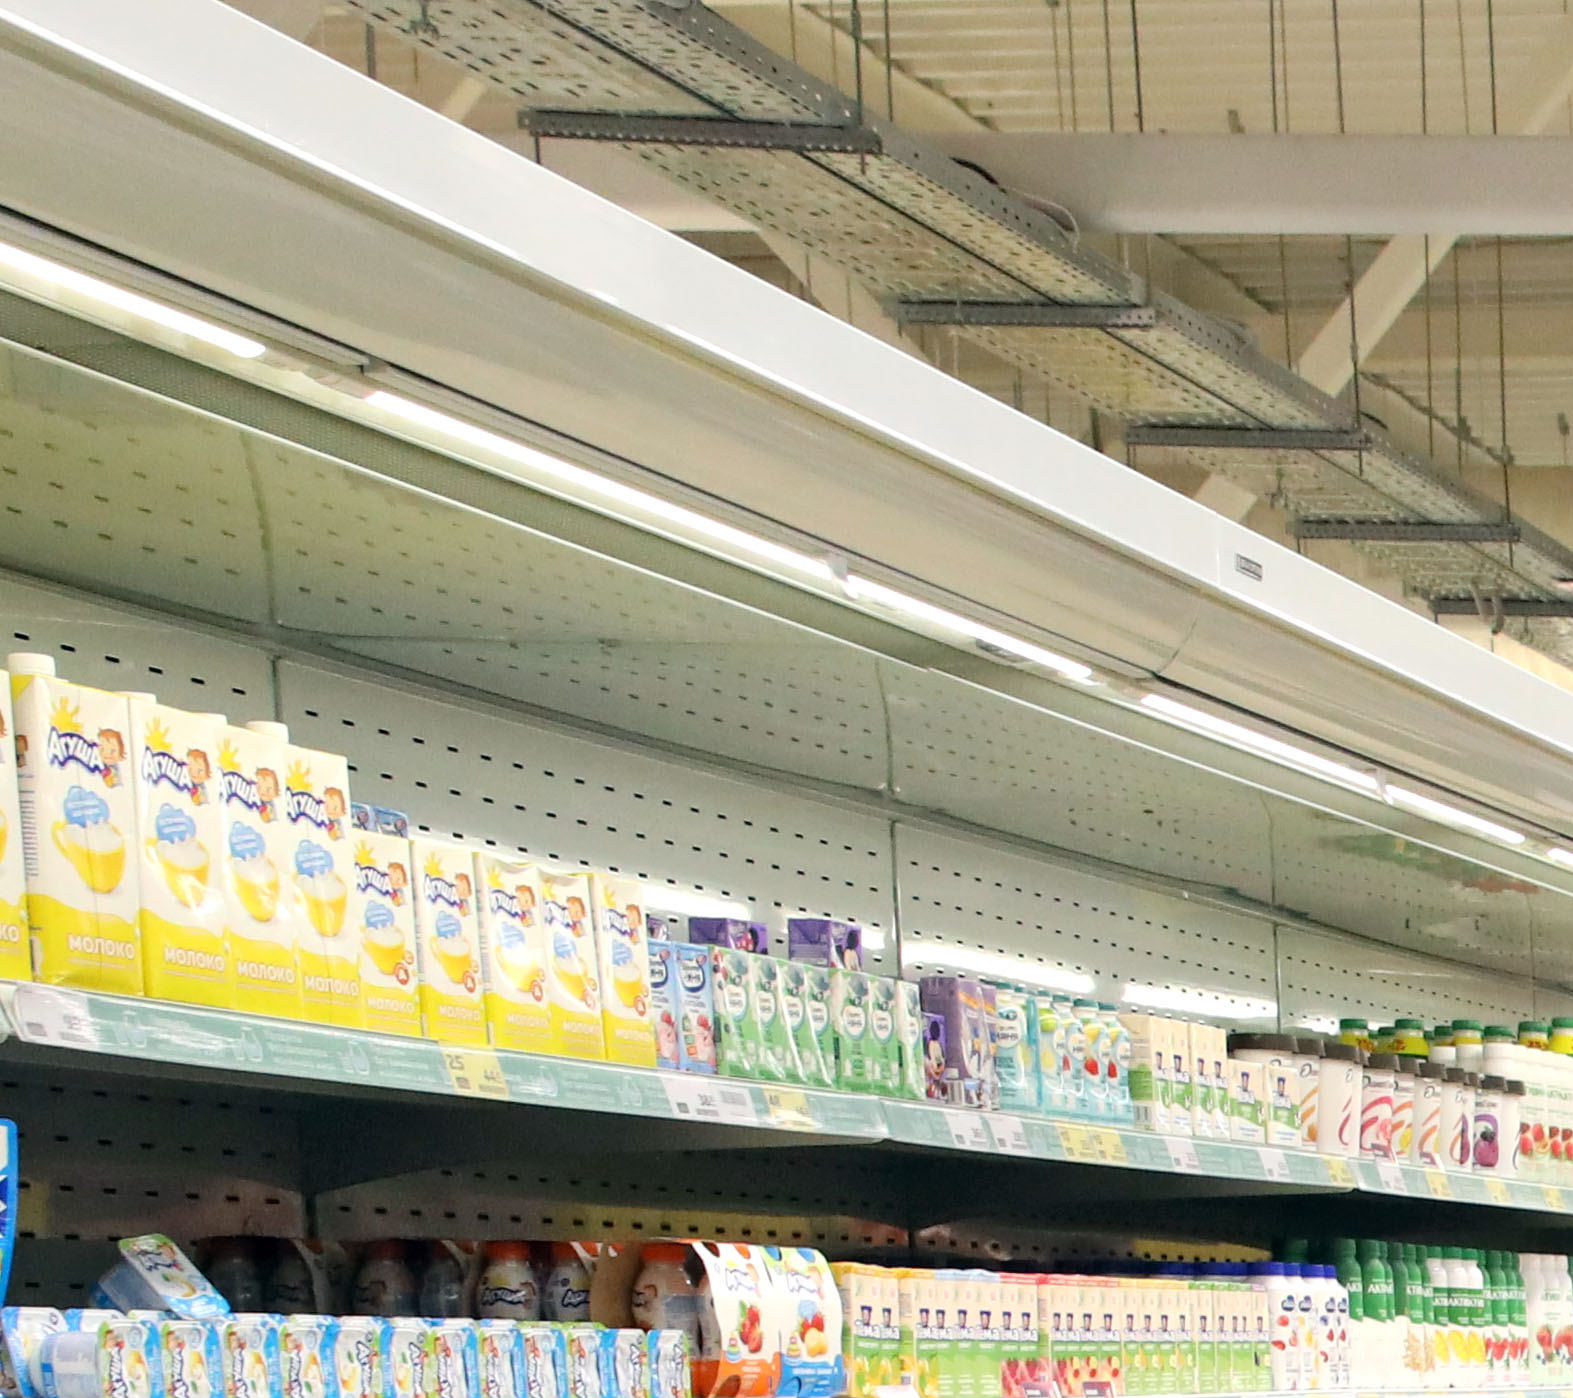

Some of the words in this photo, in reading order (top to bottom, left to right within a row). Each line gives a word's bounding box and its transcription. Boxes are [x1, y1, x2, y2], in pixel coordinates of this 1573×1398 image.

[68, 935, 136, 959] МОЛОКО
[164, 947, 225, 971] МОЛОКО
[237, 961, 295, 984] МОЛОКО
[305, 975, 359, 996] МОЛОКО
[368, 997, 414, 1014] МОЛОКО
[439, 1005, 481, 1022] МОЛОКО
